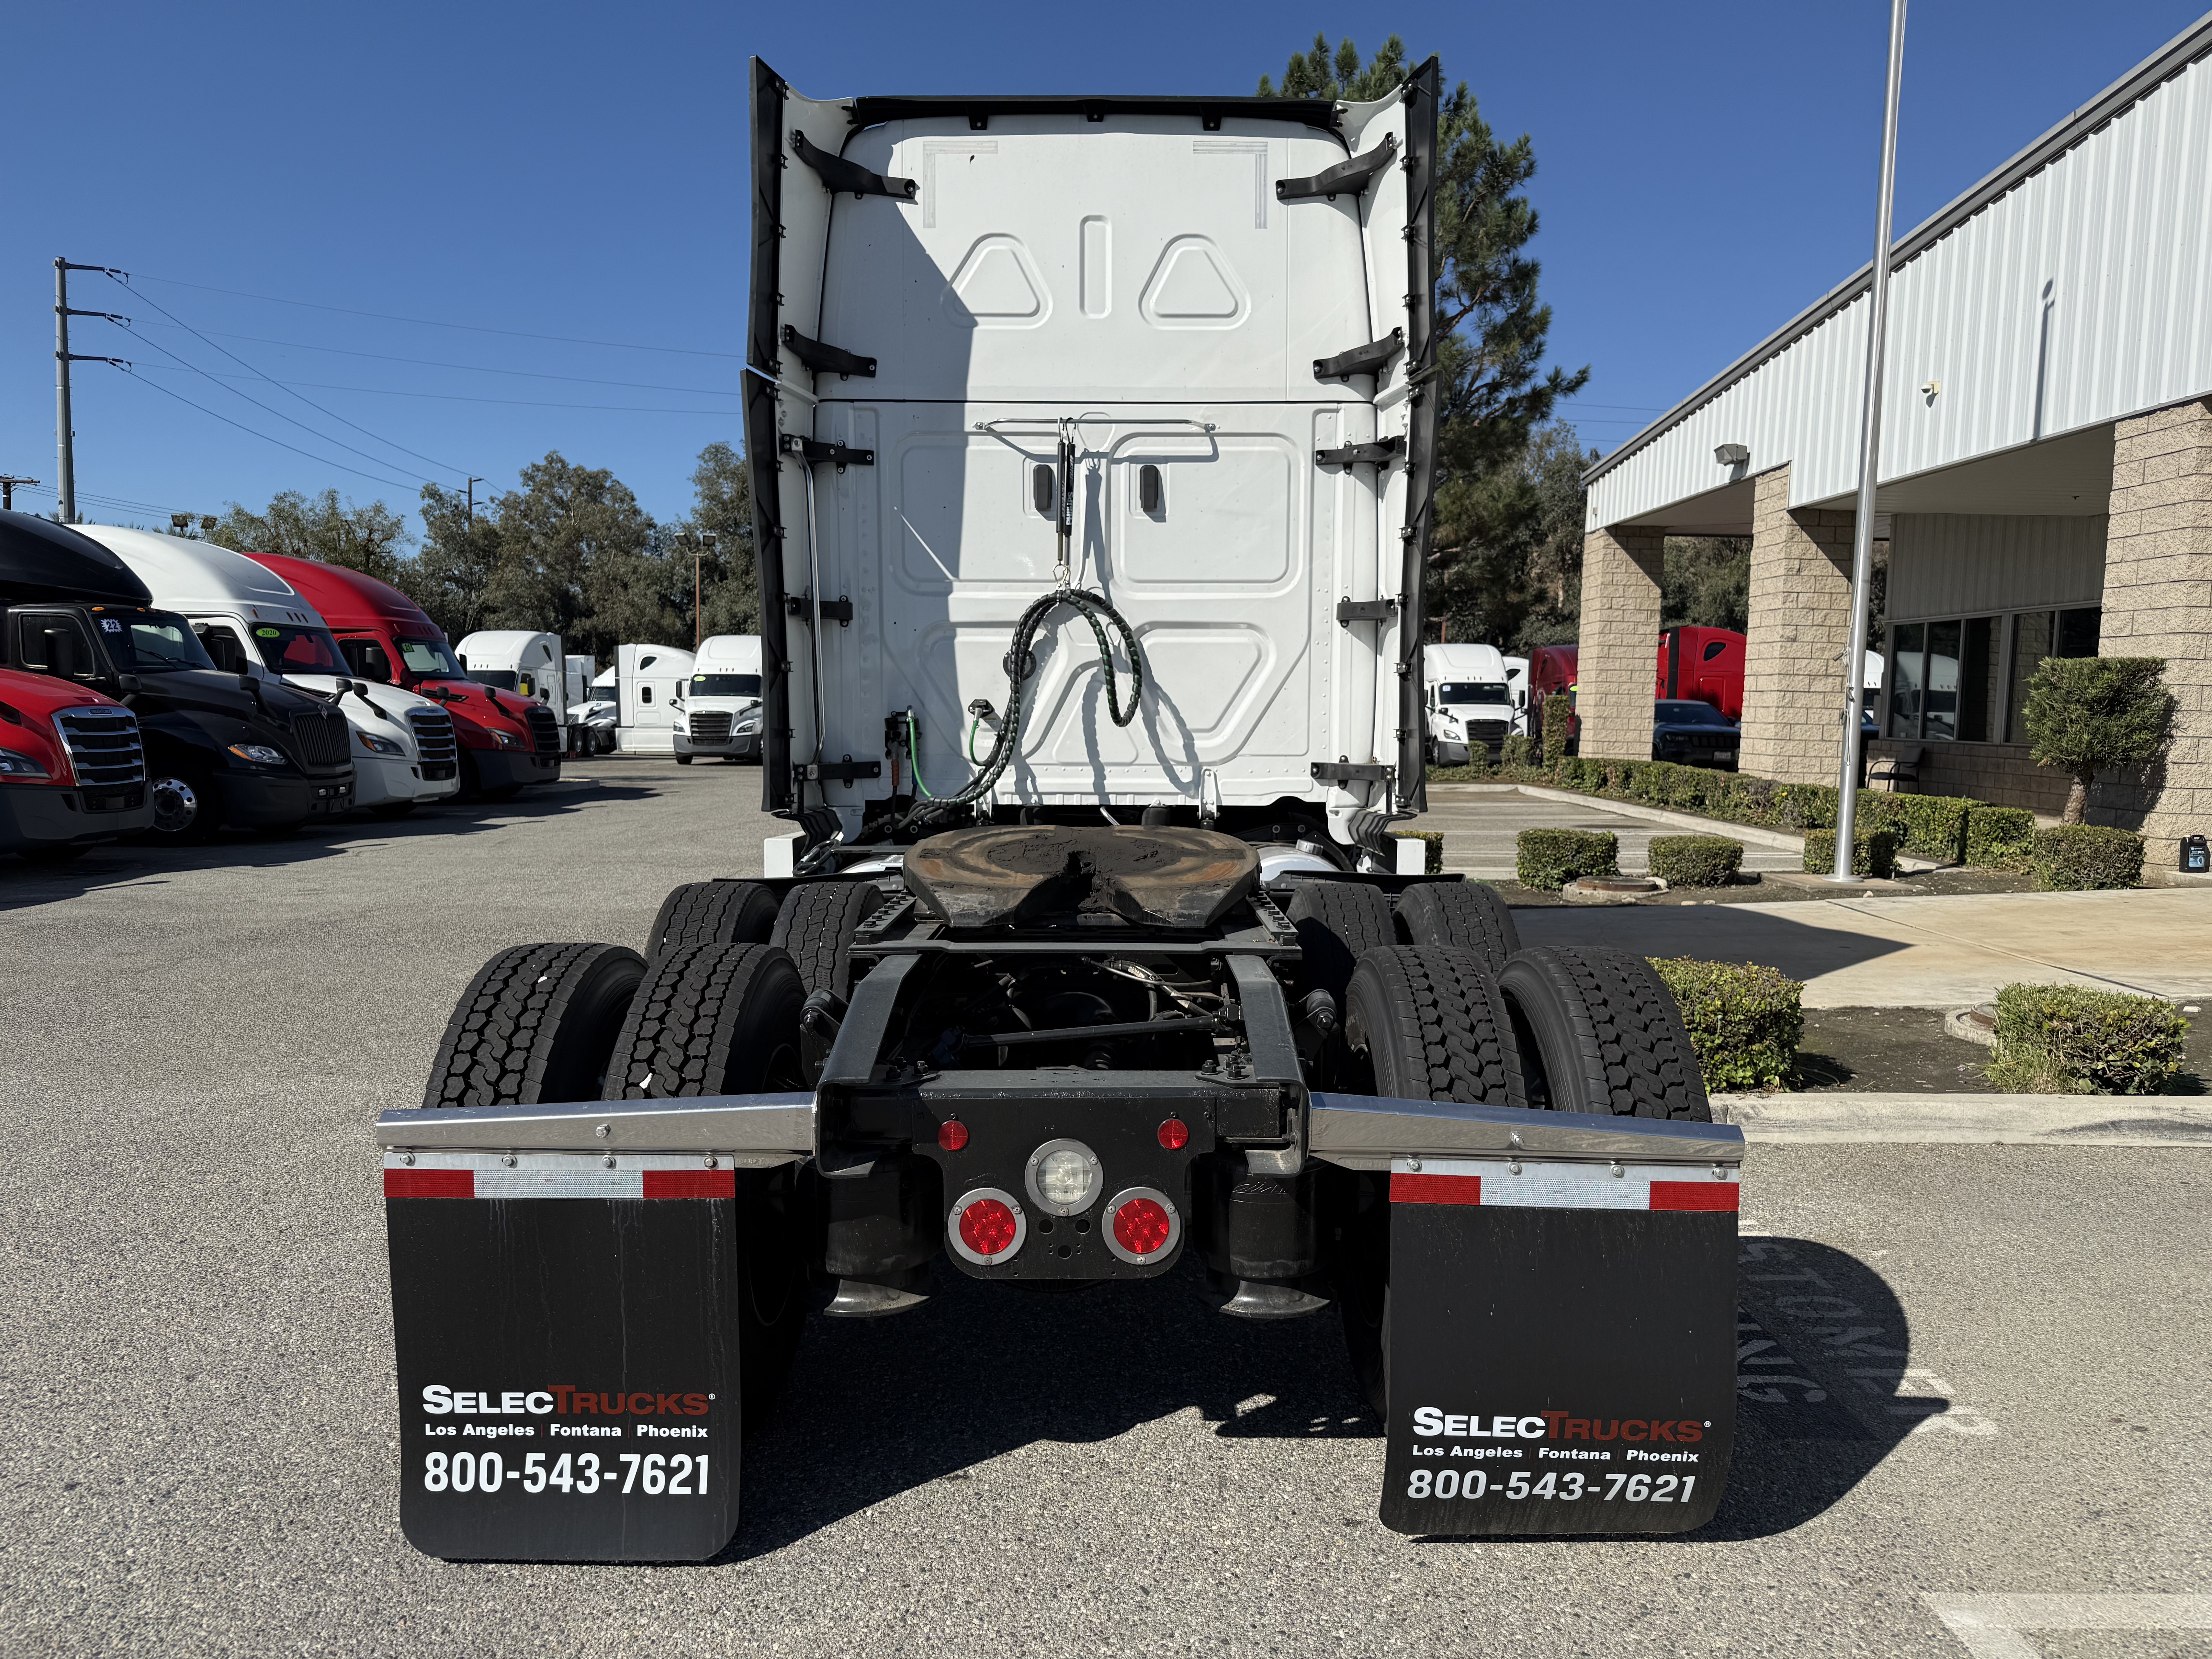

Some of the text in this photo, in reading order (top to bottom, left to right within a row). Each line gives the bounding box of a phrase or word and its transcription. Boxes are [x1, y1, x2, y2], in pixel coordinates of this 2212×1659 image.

[106, 621, 118, 630] 22
[425, 1423, 708, 1439] Los Angeles Fontana Phoenix
[1412, 1444, 1699, 1462] Los Angeles Fontana Phoenix
[424, 1451, 709, 1495] 800-543-7621
[1407, 1469, 1695, 1503] 800-543-7621
